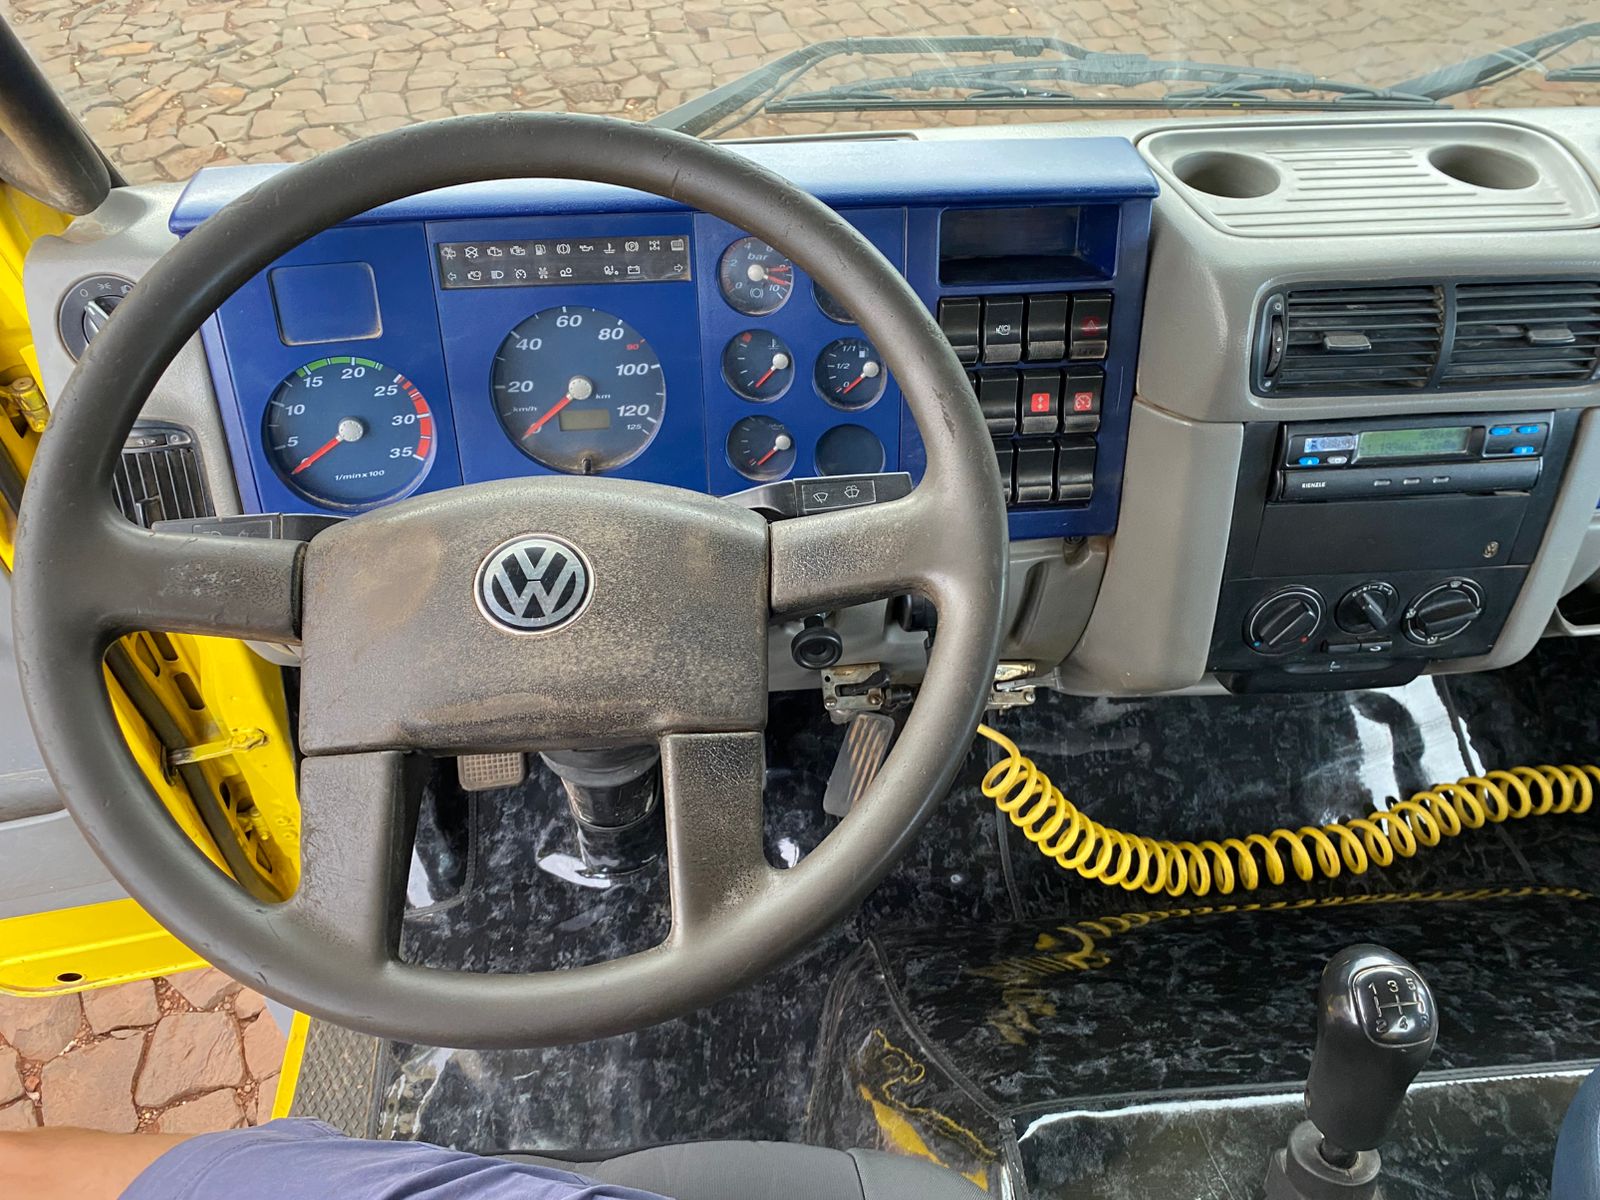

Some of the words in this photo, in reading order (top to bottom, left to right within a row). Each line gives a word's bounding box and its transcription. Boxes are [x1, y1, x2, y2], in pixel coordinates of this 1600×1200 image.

[747, 252, 768, 260] bar
[730, 259, 738, 267] 2
[769, 284, 780, 292] 10
[556, 315, 583, 328] 60
[598, 328, 624, 341] 80
[516, 338, 542, 351] 40
[626, 343, 640, 351] 90
[341, 367, 366, 380] 20
[615, 363, 649, 376] 100
[303, 376, 324, 388] 15
[507, 380, 534, 393] 20
[374, 384, 398, 397] 25
[285, 404, 306, 416] 10
[617, 404, 650, 417] 120
[391, 414, 416, 426] 30
[627, 423, 643, 431] 125
[287, 436, 299, 448] 5
[389, 447, 413, 459] 35
[1301, 481, 1326, 489] KIENZLE
[486, 541, 583, 624] VW
[1368, 982, 1377, 995] 1
[1387, 980, 1399, 993] 3
[1405, 978, 1417, 991] 5
[1375, 1019, 1388, 1033] 2
[1399, 1015, 1409, 1031] 4
